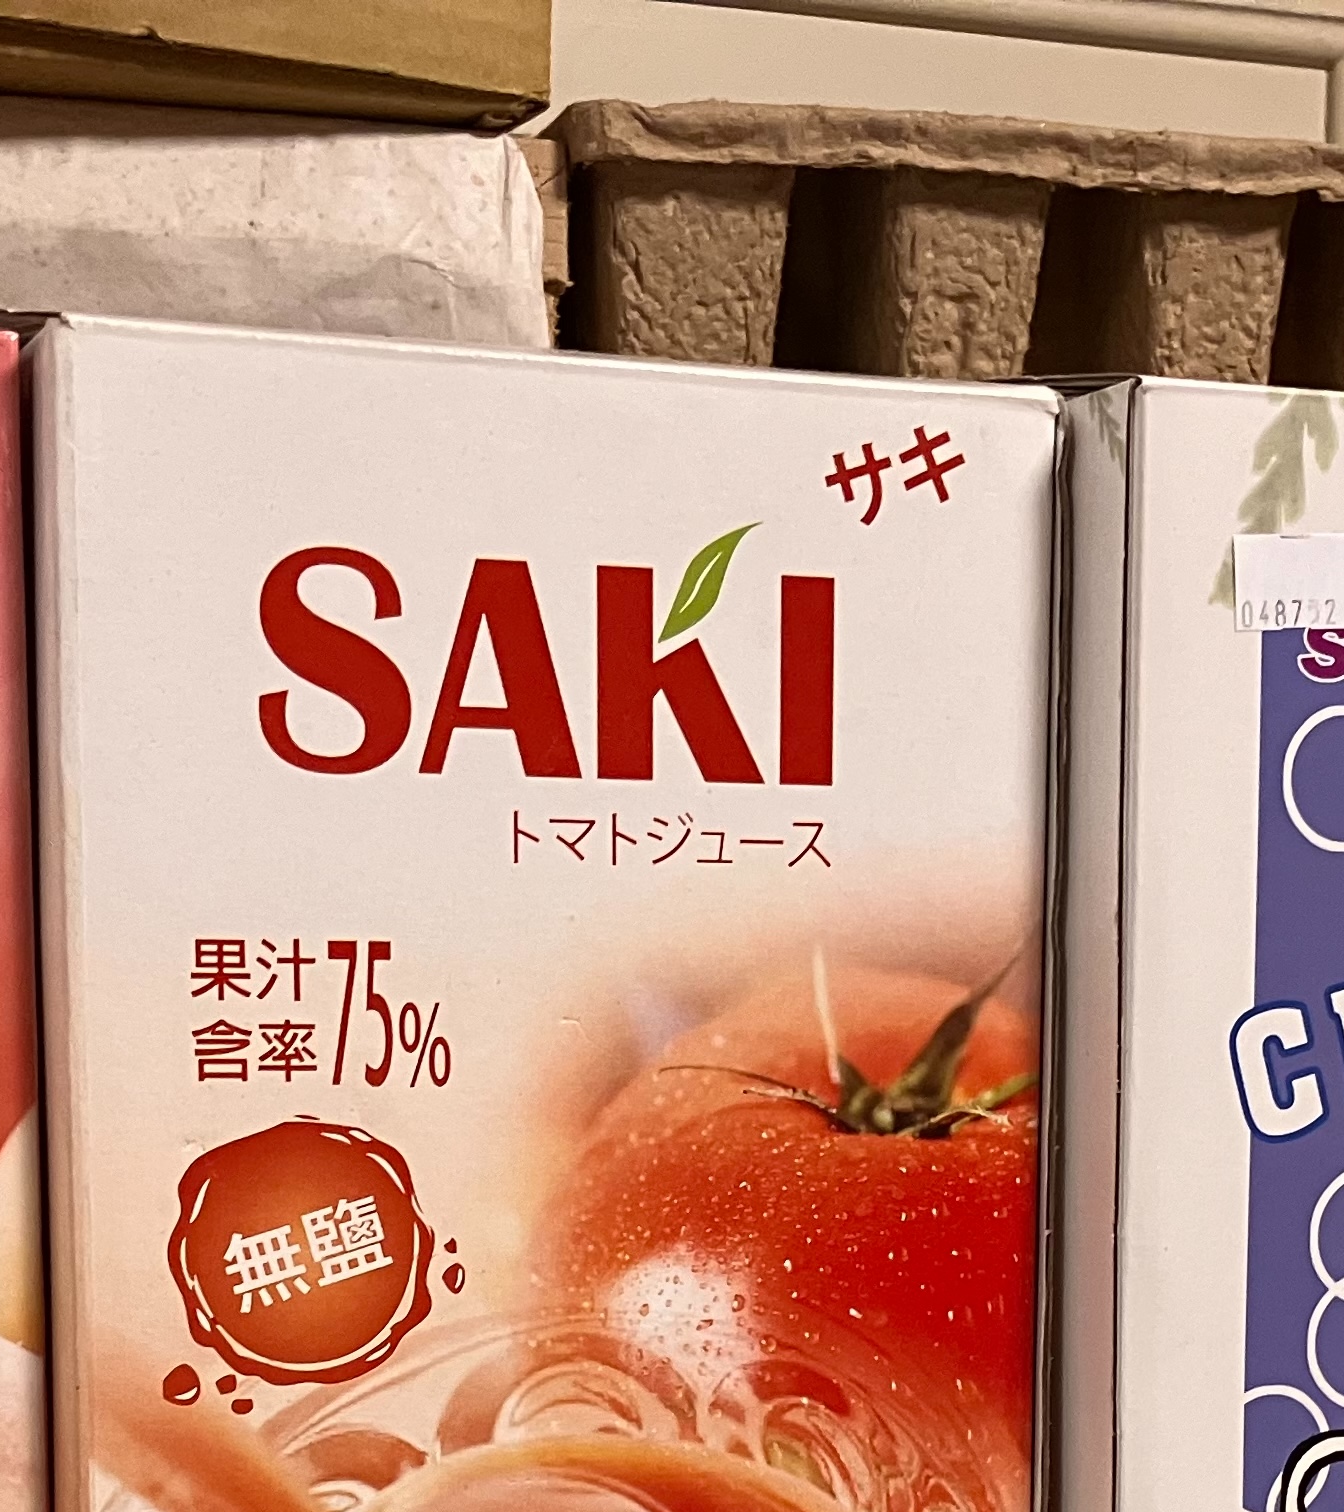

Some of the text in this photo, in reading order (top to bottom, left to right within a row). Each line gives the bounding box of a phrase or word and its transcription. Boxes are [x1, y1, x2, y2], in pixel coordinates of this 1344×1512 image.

[824, 425, 967, 526] サキ
[258, 522, 836, 787] SAKI
[513, 810, 832, 869] トマトジュース
[327, 940, 452, 1089] 75%
[222, 1194, 394, 1315] 無鹽
